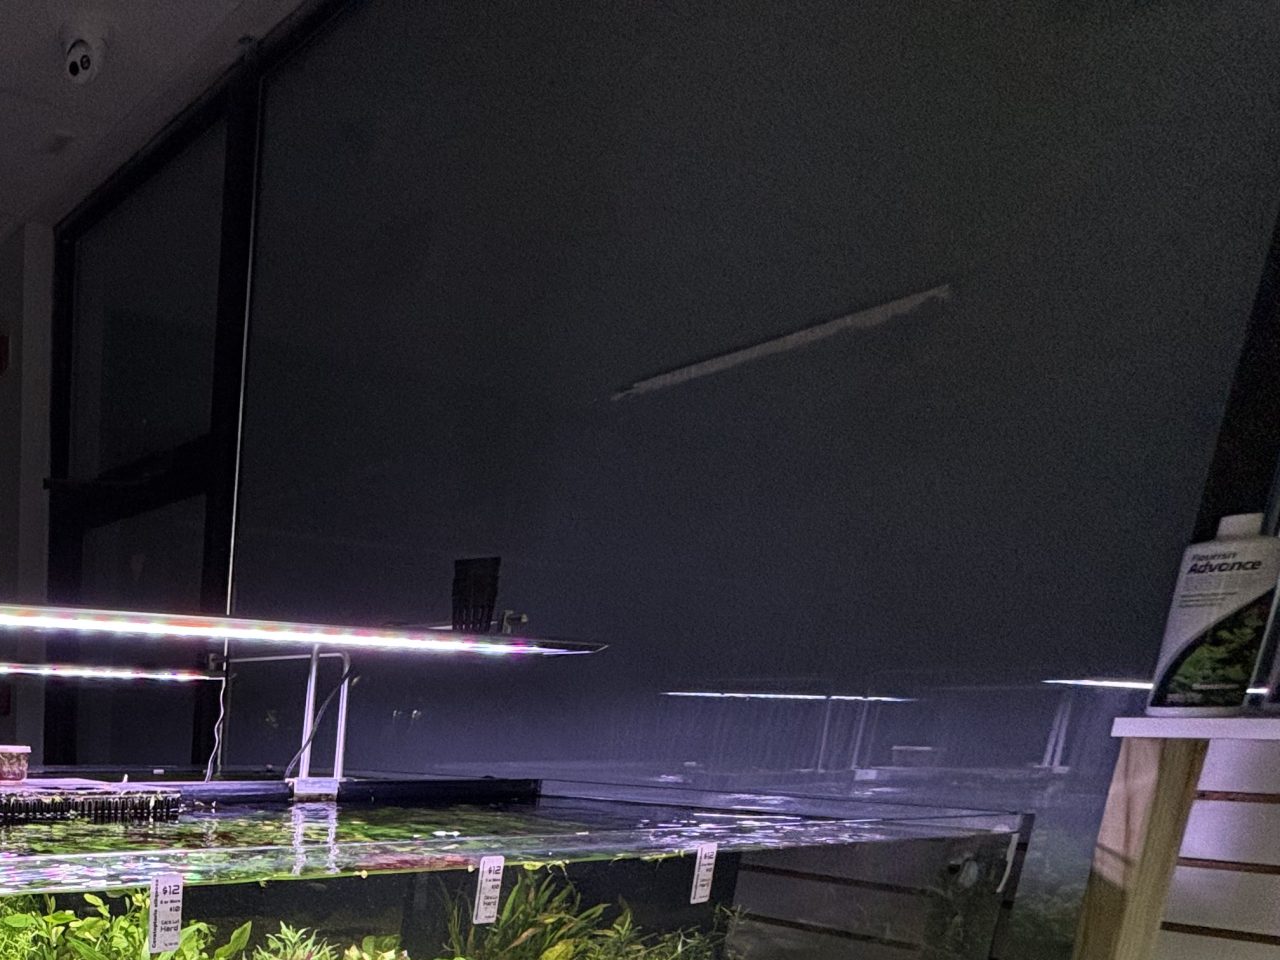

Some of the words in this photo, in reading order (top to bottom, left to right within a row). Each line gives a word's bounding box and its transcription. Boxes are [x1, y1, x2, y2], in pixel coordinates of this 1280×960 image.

[1187, 560, 1262, 575] Advance
[489, 866, 501, 874] $12
[163, 885, 180, 895] $12
